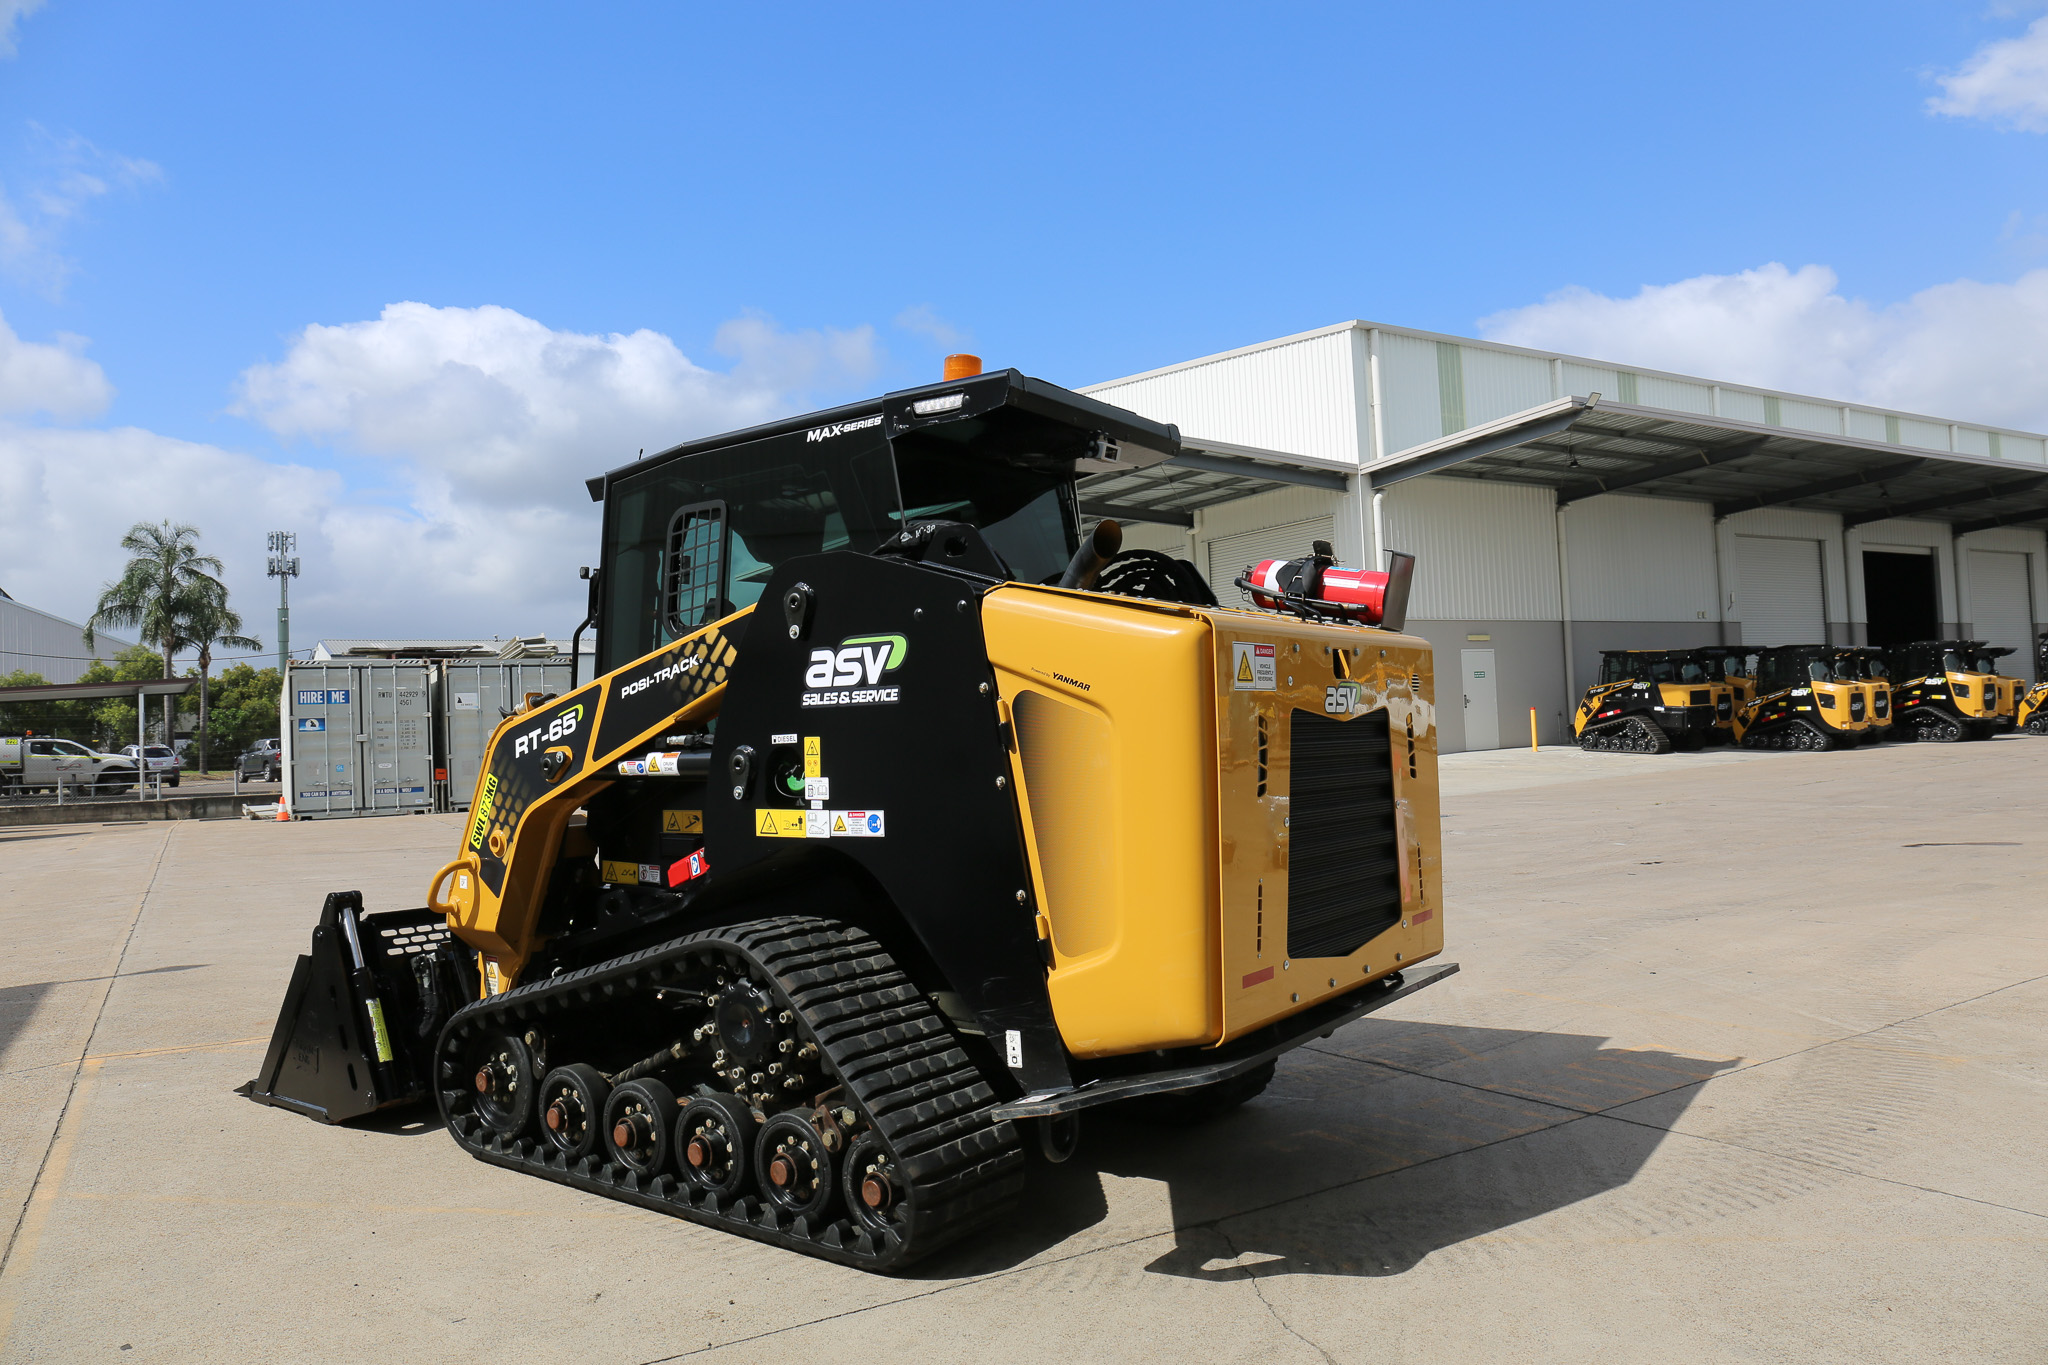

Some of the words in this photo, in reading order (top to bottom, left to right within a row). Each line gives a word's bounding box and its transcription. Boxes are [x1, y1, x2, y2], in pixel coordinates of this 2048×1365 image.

[806, 416, 882, 443] MAX-SERIES
[621, 654, 700, 699] POSI-TRACK
[1053, 671, 1091, 692] YANMAR
[300, 691, 323, 704] HIRE
[331, 690, 346, 703] ME
[399, 690, 418, 698] 442929
[851, 688, 898, 703] SERVICE
[515, 710, 578, 759] RT-65
[472, 818, 485, 846] SWL
[481, 776, 497, 817] 873KG
